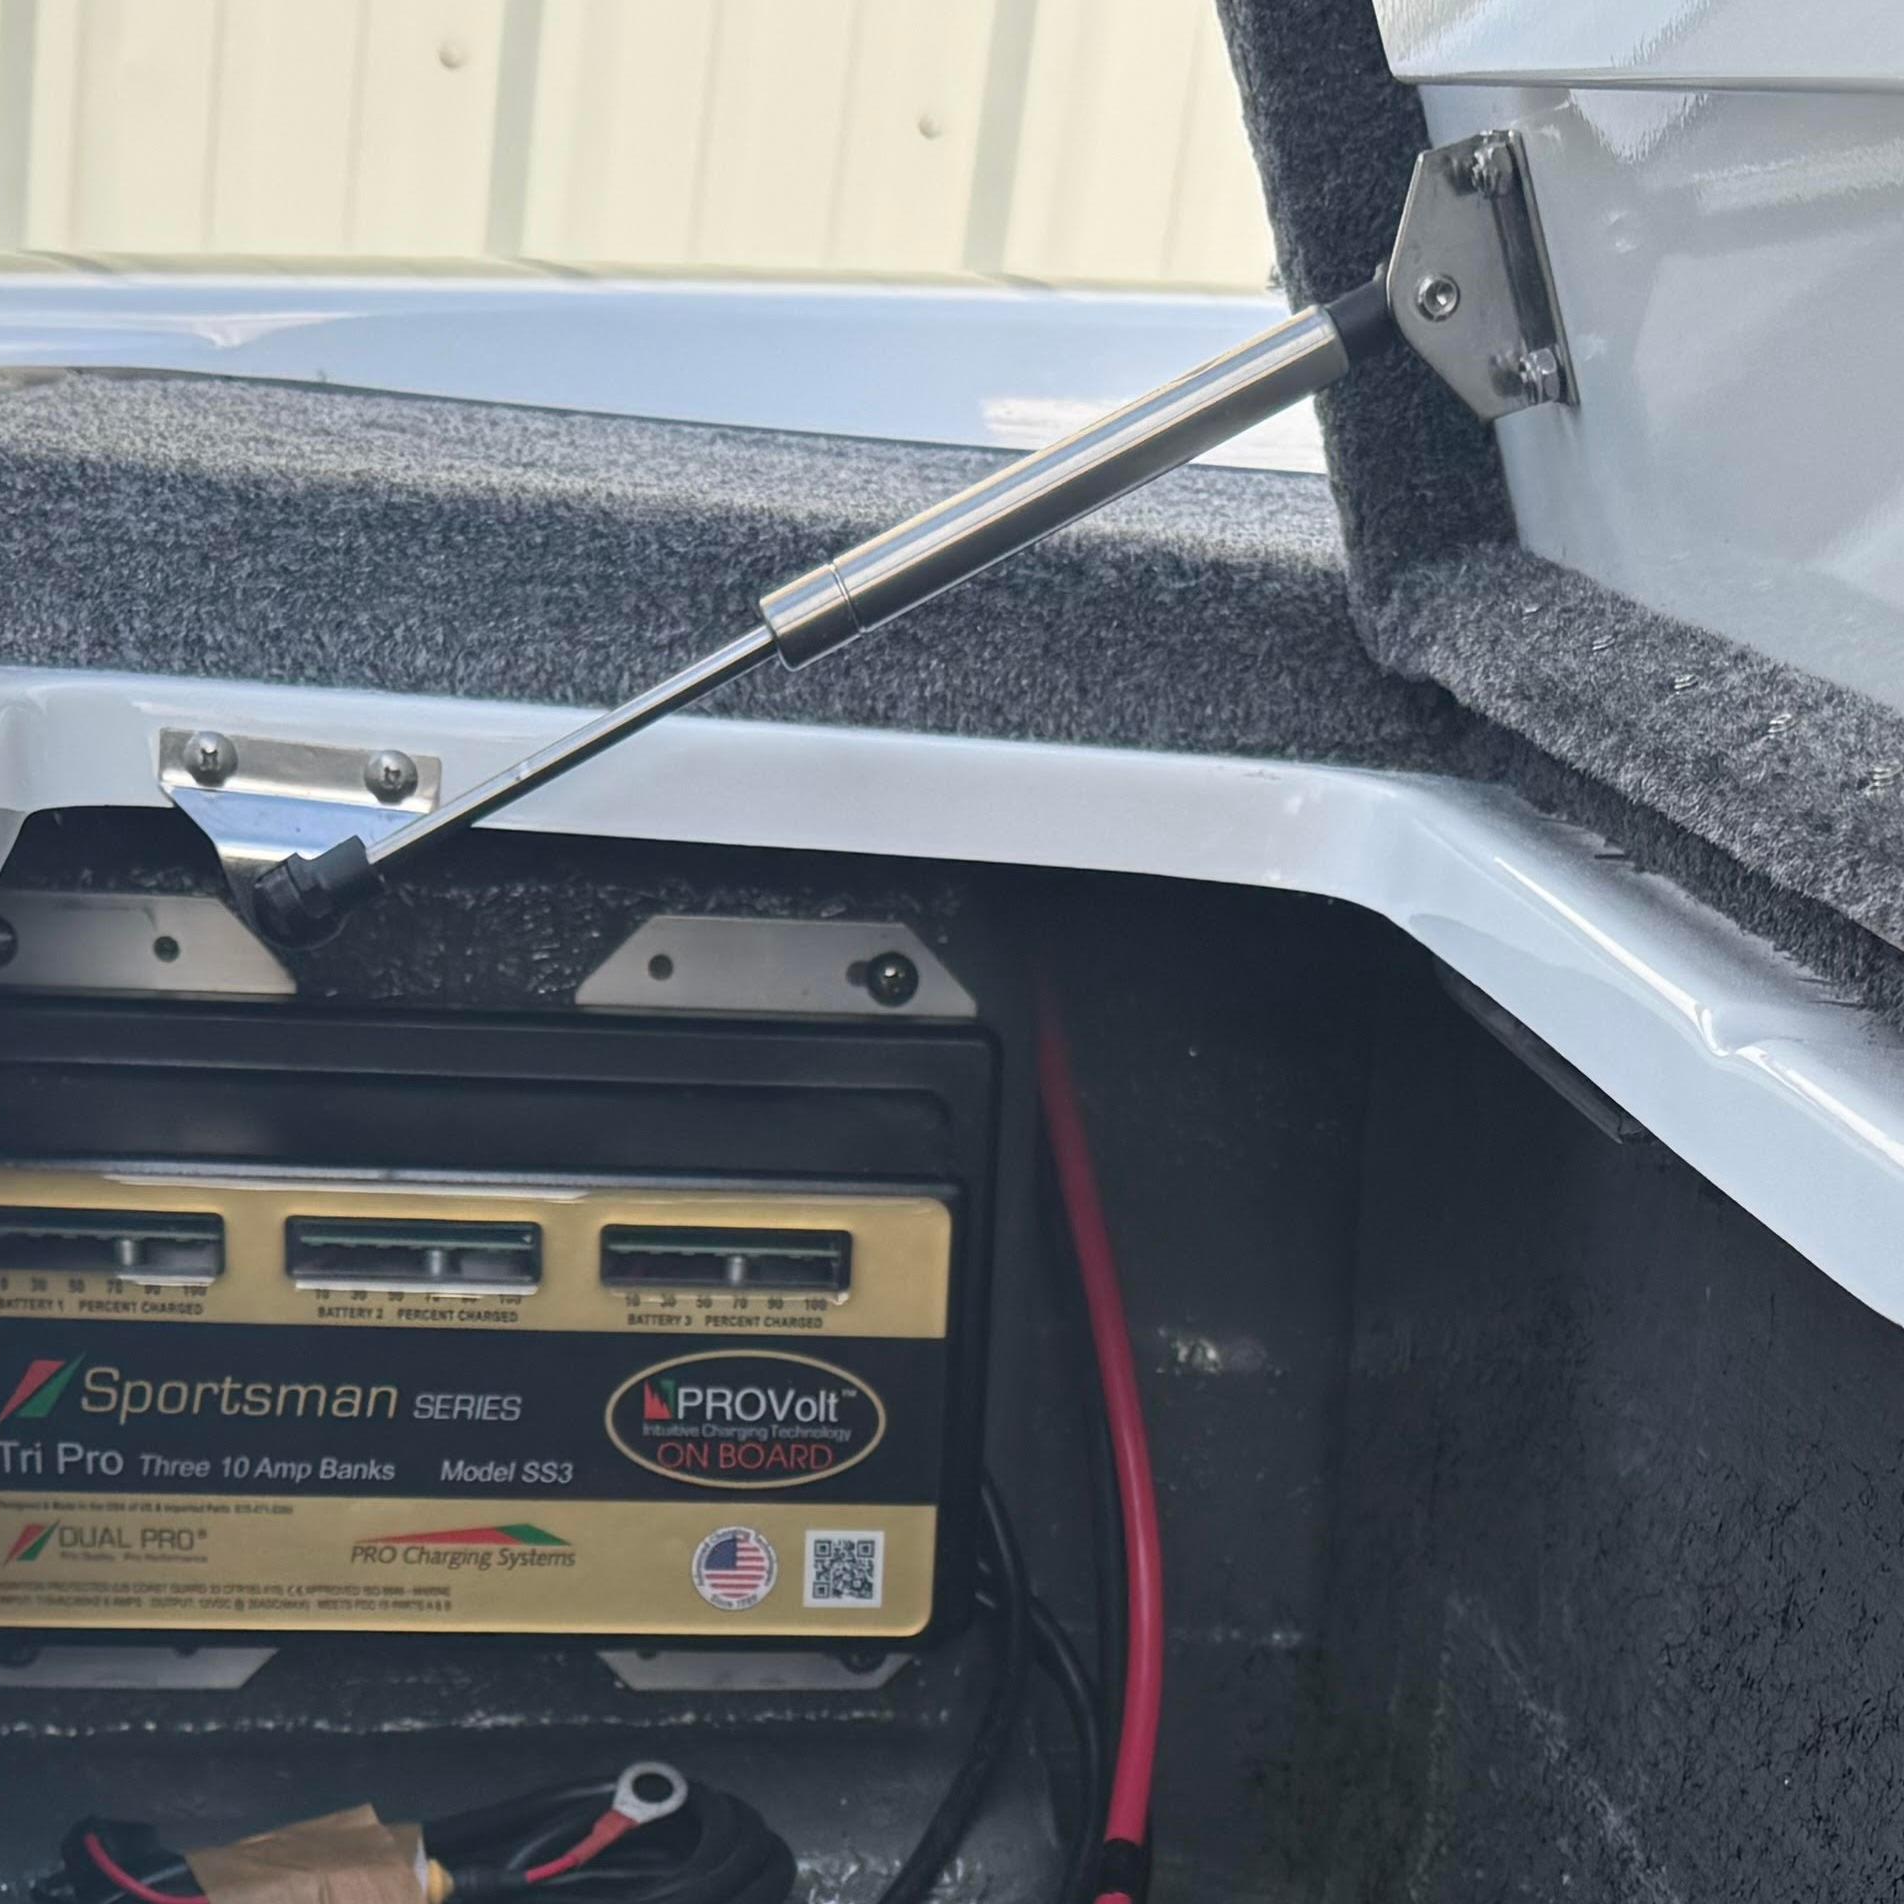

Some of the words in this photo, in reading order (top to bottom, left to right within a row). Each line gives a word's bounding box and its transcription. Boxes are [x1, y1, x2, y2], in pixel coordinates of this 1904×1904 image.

[78, 1299, 138, 1314] PERCENT
[140, 1301, 204, 1316] CHARGED
[317, 1305, 373, 1319] BATTERY
[397, 1307, 455, 1321] PERCENT
[457, 1309, 519, 1323] CHARGED
[627, 1313, 682, 1326] BATTERY
[704, 1314, 761, 1328] PERCENT
[762, 1316, 824, 1329] CHARGED
[80, 1366, 398, 1426] Sportsman
[412, 1393, 523, 1422] SERIES
[642, 1423, 700, 1439] Intuitive
[701, 1423, 769, 1442] Charging
[770, 1424, 852, 1443] Technology
[56, 1441, 125, 1477] Pro
[138, 1453, 212, 1479] Three
[221, 1456, 250, 1480] 10
[253, 1457, 313, 1483] Amp
[317, 1457, 396, 1482] Banks
[656, 1442, 709, 1470] ON
[718, 1443, 833, 1471] BOARD
[439, 1460, 516, 1483] Model
[520, 1461, 575, 1484] SS3
[58, 1525, 132, 1550] DUAL
[349, 1545, 397, 1565] PRO
[402, 1545, 492, 1572] Charging
[496, 1547, 577, 1572] Systems
